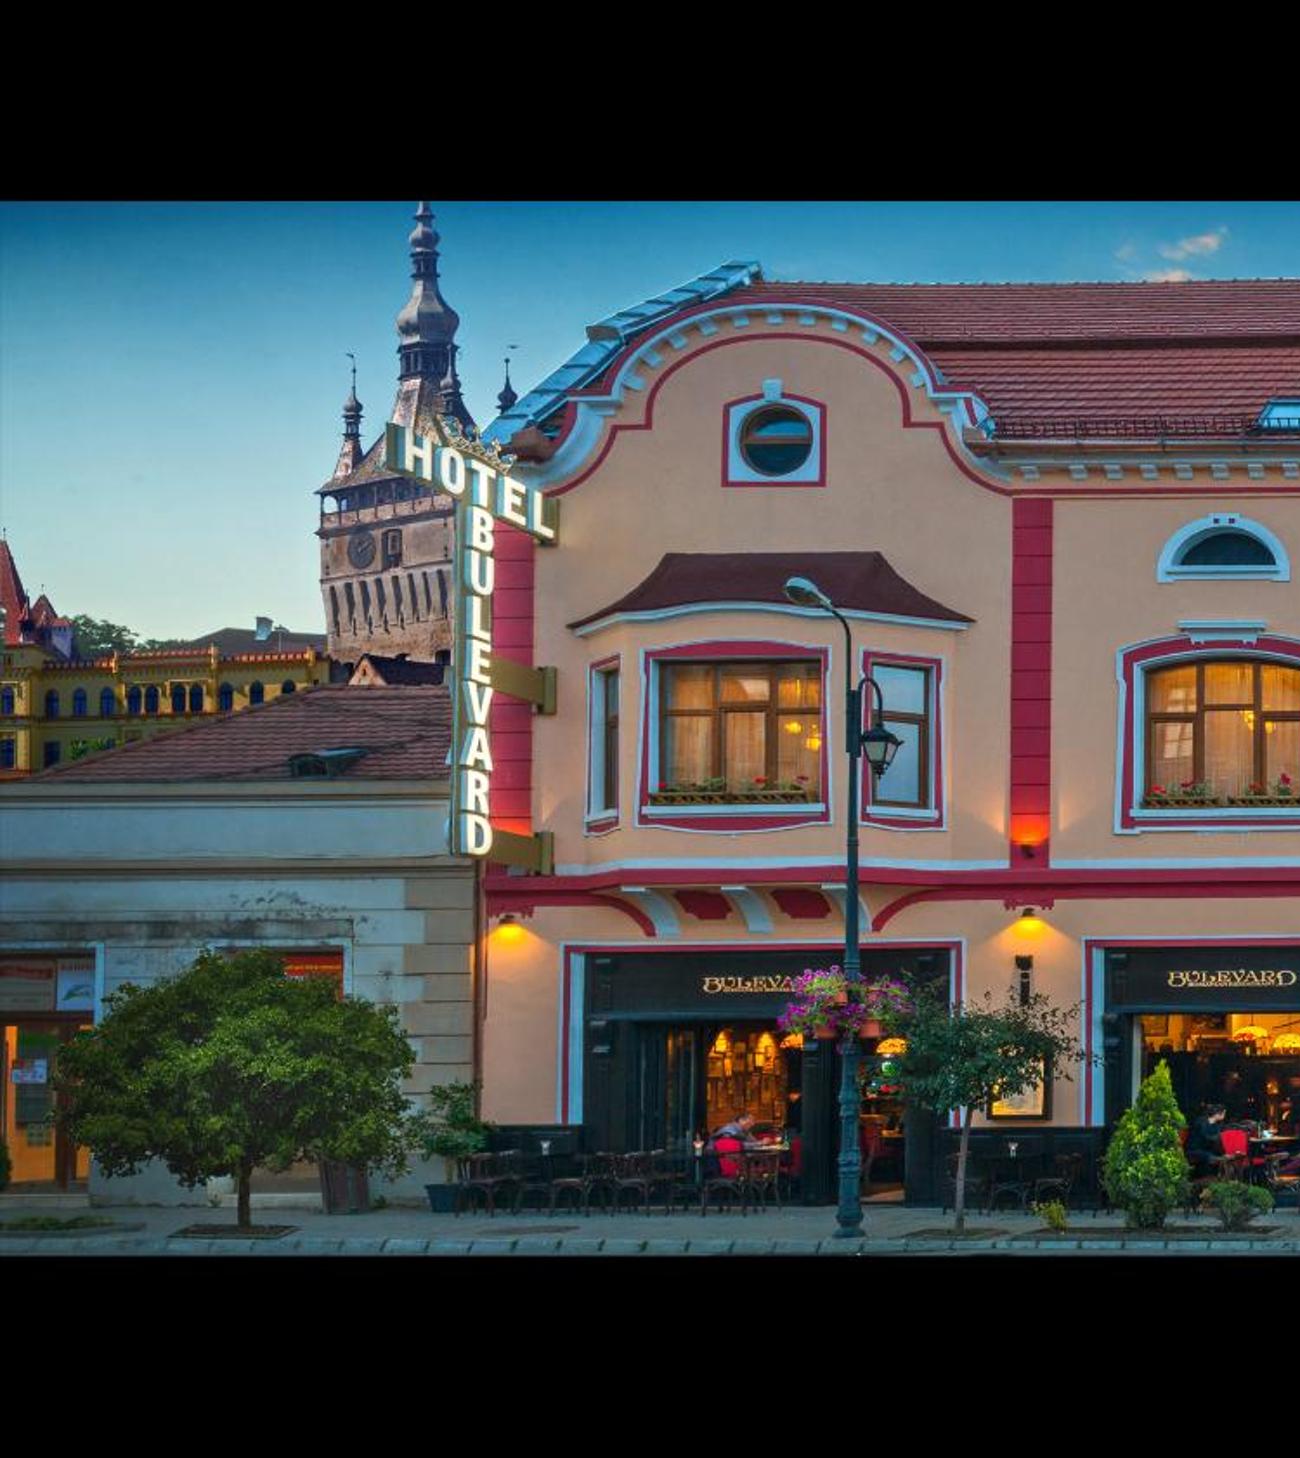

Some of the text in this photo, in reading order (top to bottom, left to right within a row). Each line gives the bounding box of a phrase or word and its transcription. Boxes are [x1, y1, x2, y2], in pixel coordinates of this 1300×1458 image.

[402, 427, 555, 539] HOTEL
[464, 505, 495, 856] BULEVARD
[703, 975, 798, 993] BULEVA
[1167, 969, 1297, 987] BULEVARD
